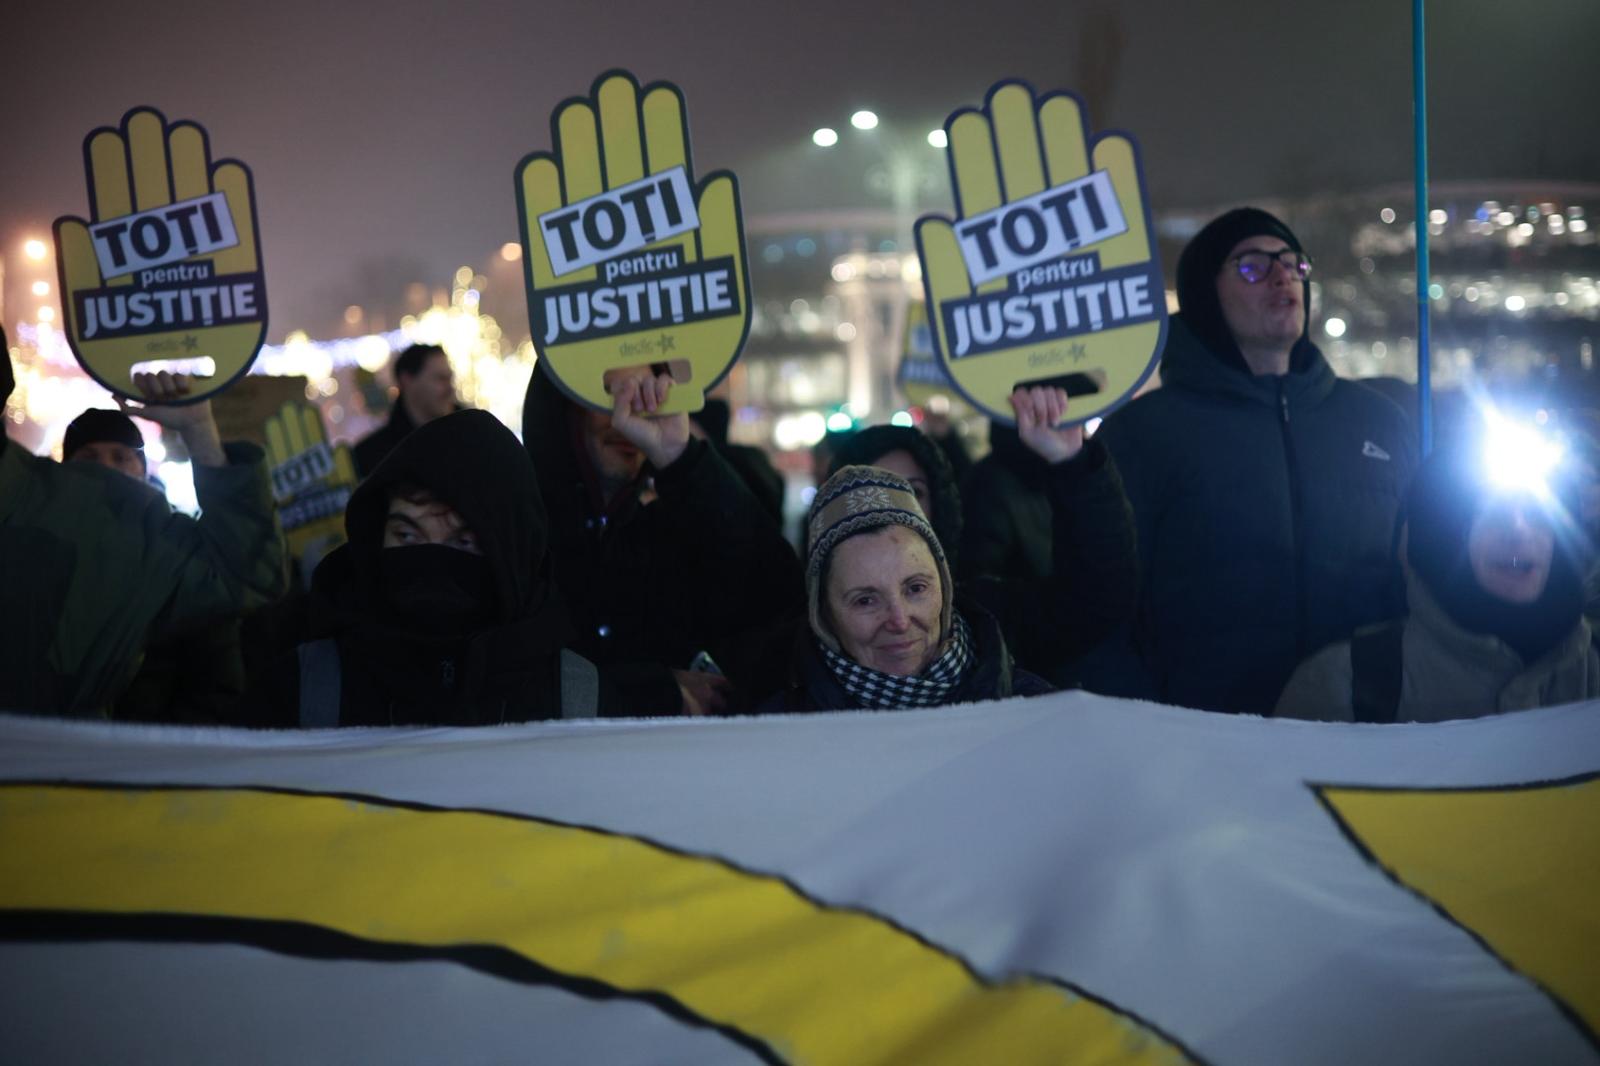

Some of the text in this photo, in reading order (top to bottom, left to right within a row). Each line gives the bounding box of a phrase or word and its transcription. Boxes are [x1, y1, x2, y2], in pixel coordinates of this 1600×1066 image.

[94, 201, 223, 268] TOȚI
[545, 177, 683, 263] TOȚI
[961, 182, 1108, 271] TOȚI
[141, 264, 209, 288] pentru
[605, 252, 678, 283] pentru
[1016, 258, 1094, 293] pentru
[83, 283, 257, 339] JUSTIȚIE
[544, 270, 732, 345] JUSTIȚIE
[953, 275, 1153, 357] JUSTIȚIE
